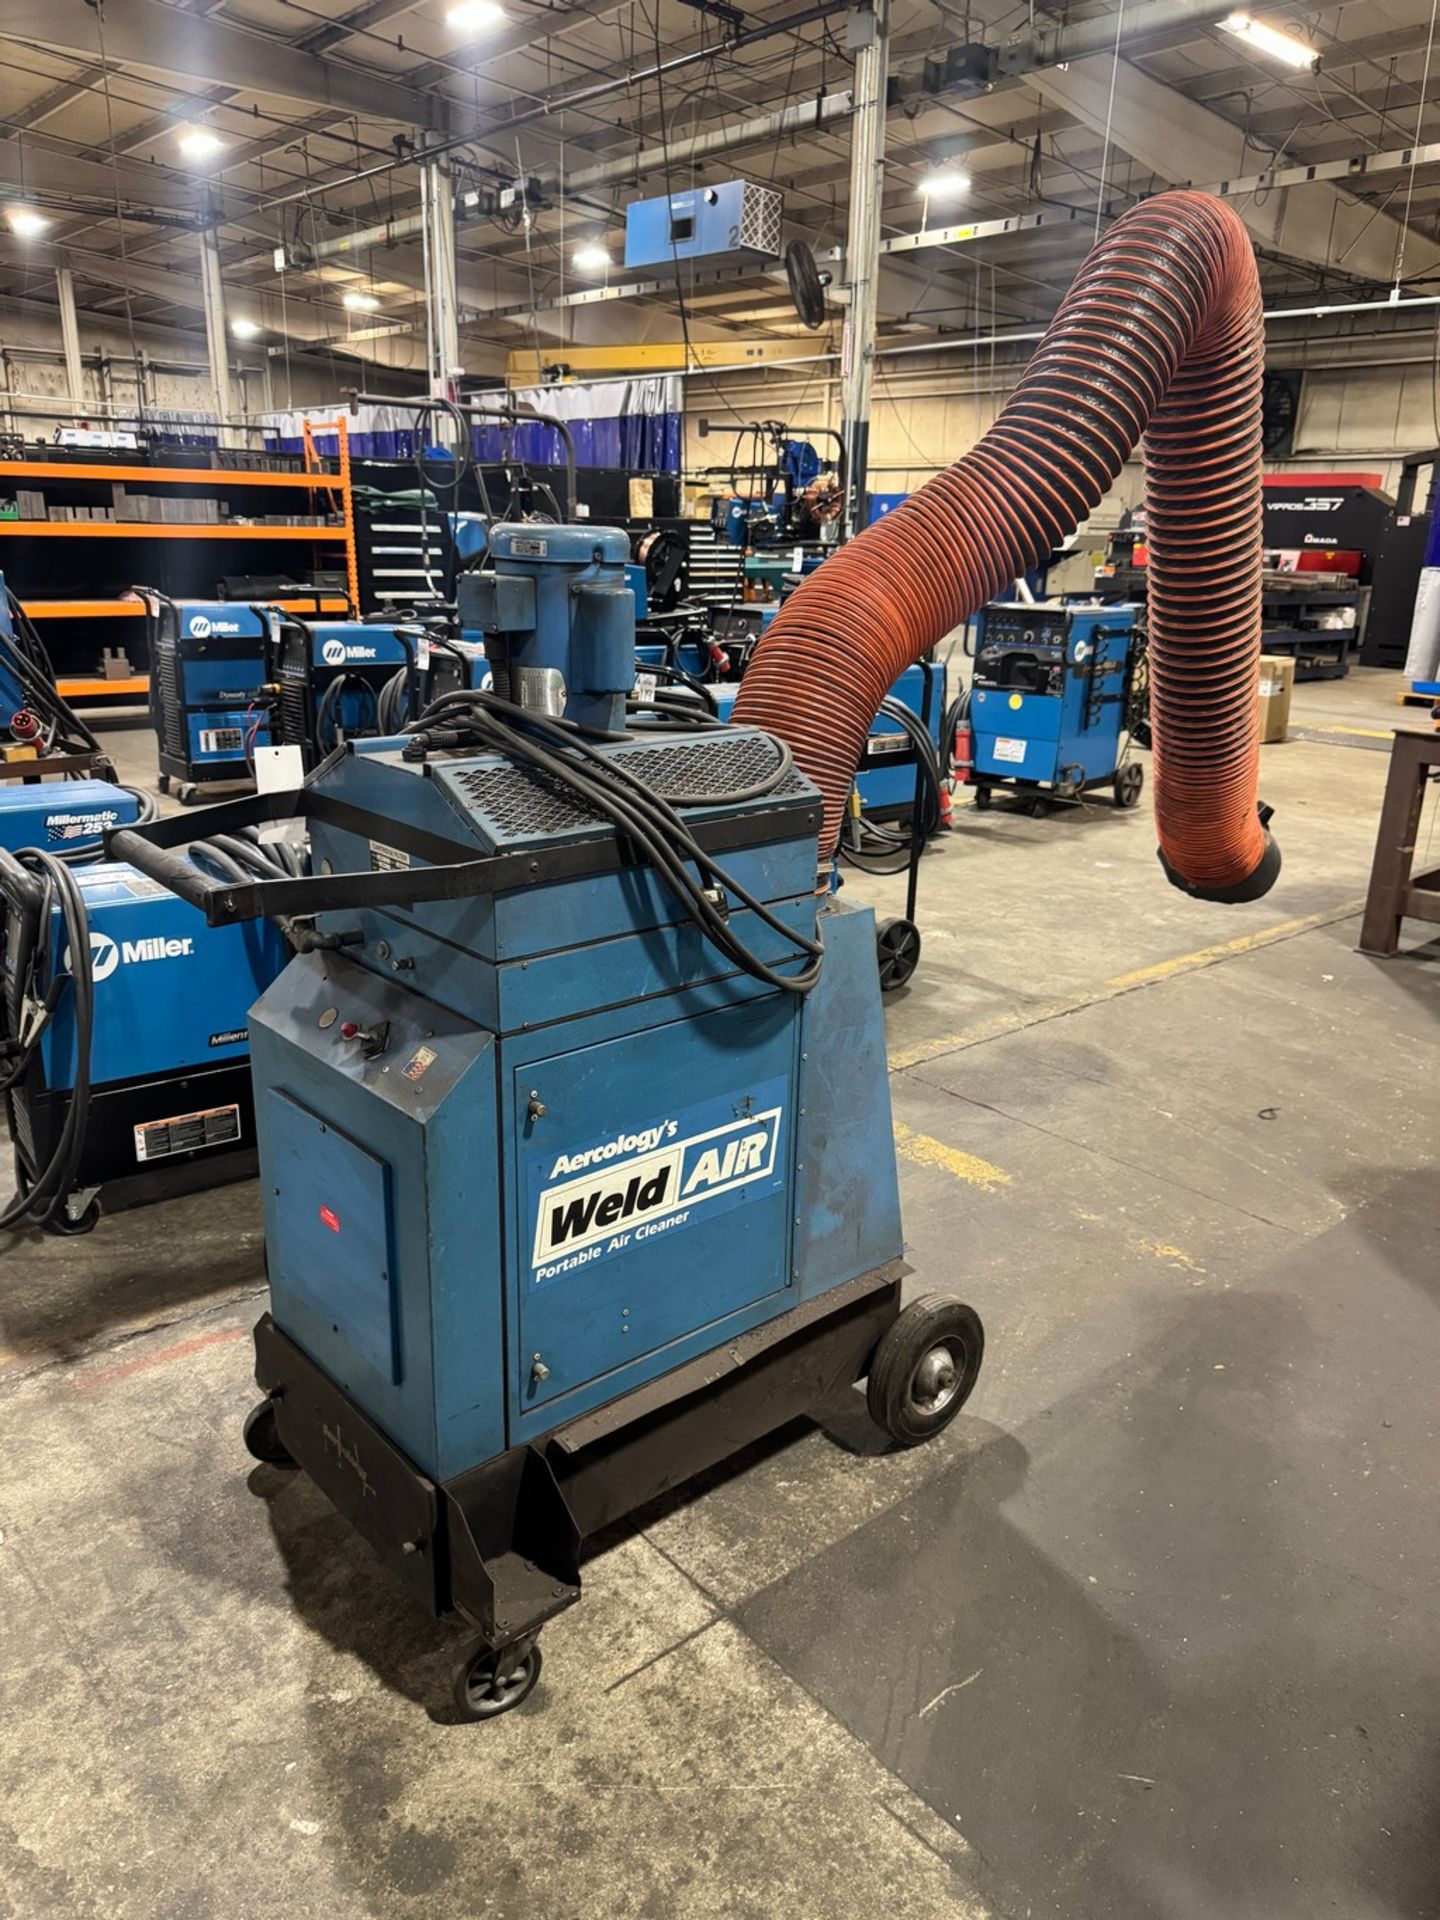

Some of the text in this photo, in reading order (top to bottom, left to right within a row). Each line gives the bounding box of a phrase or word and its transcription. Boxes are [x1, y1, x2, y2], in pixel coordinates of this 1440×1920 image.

[728, 224, 739, 248] 2
[1303, 497, 1345, 511] 357
[211, 621, 240, 633] Miller
[346, 645, 376, 658] Miller
[46, 810, 118, 827] Millermatic
[549, 1119, 678, 1180] Aercology's
[551, 1131, 768, 1247] Weld AIR
[535, 1211, 690, 1283] Portable Air Cleaner
